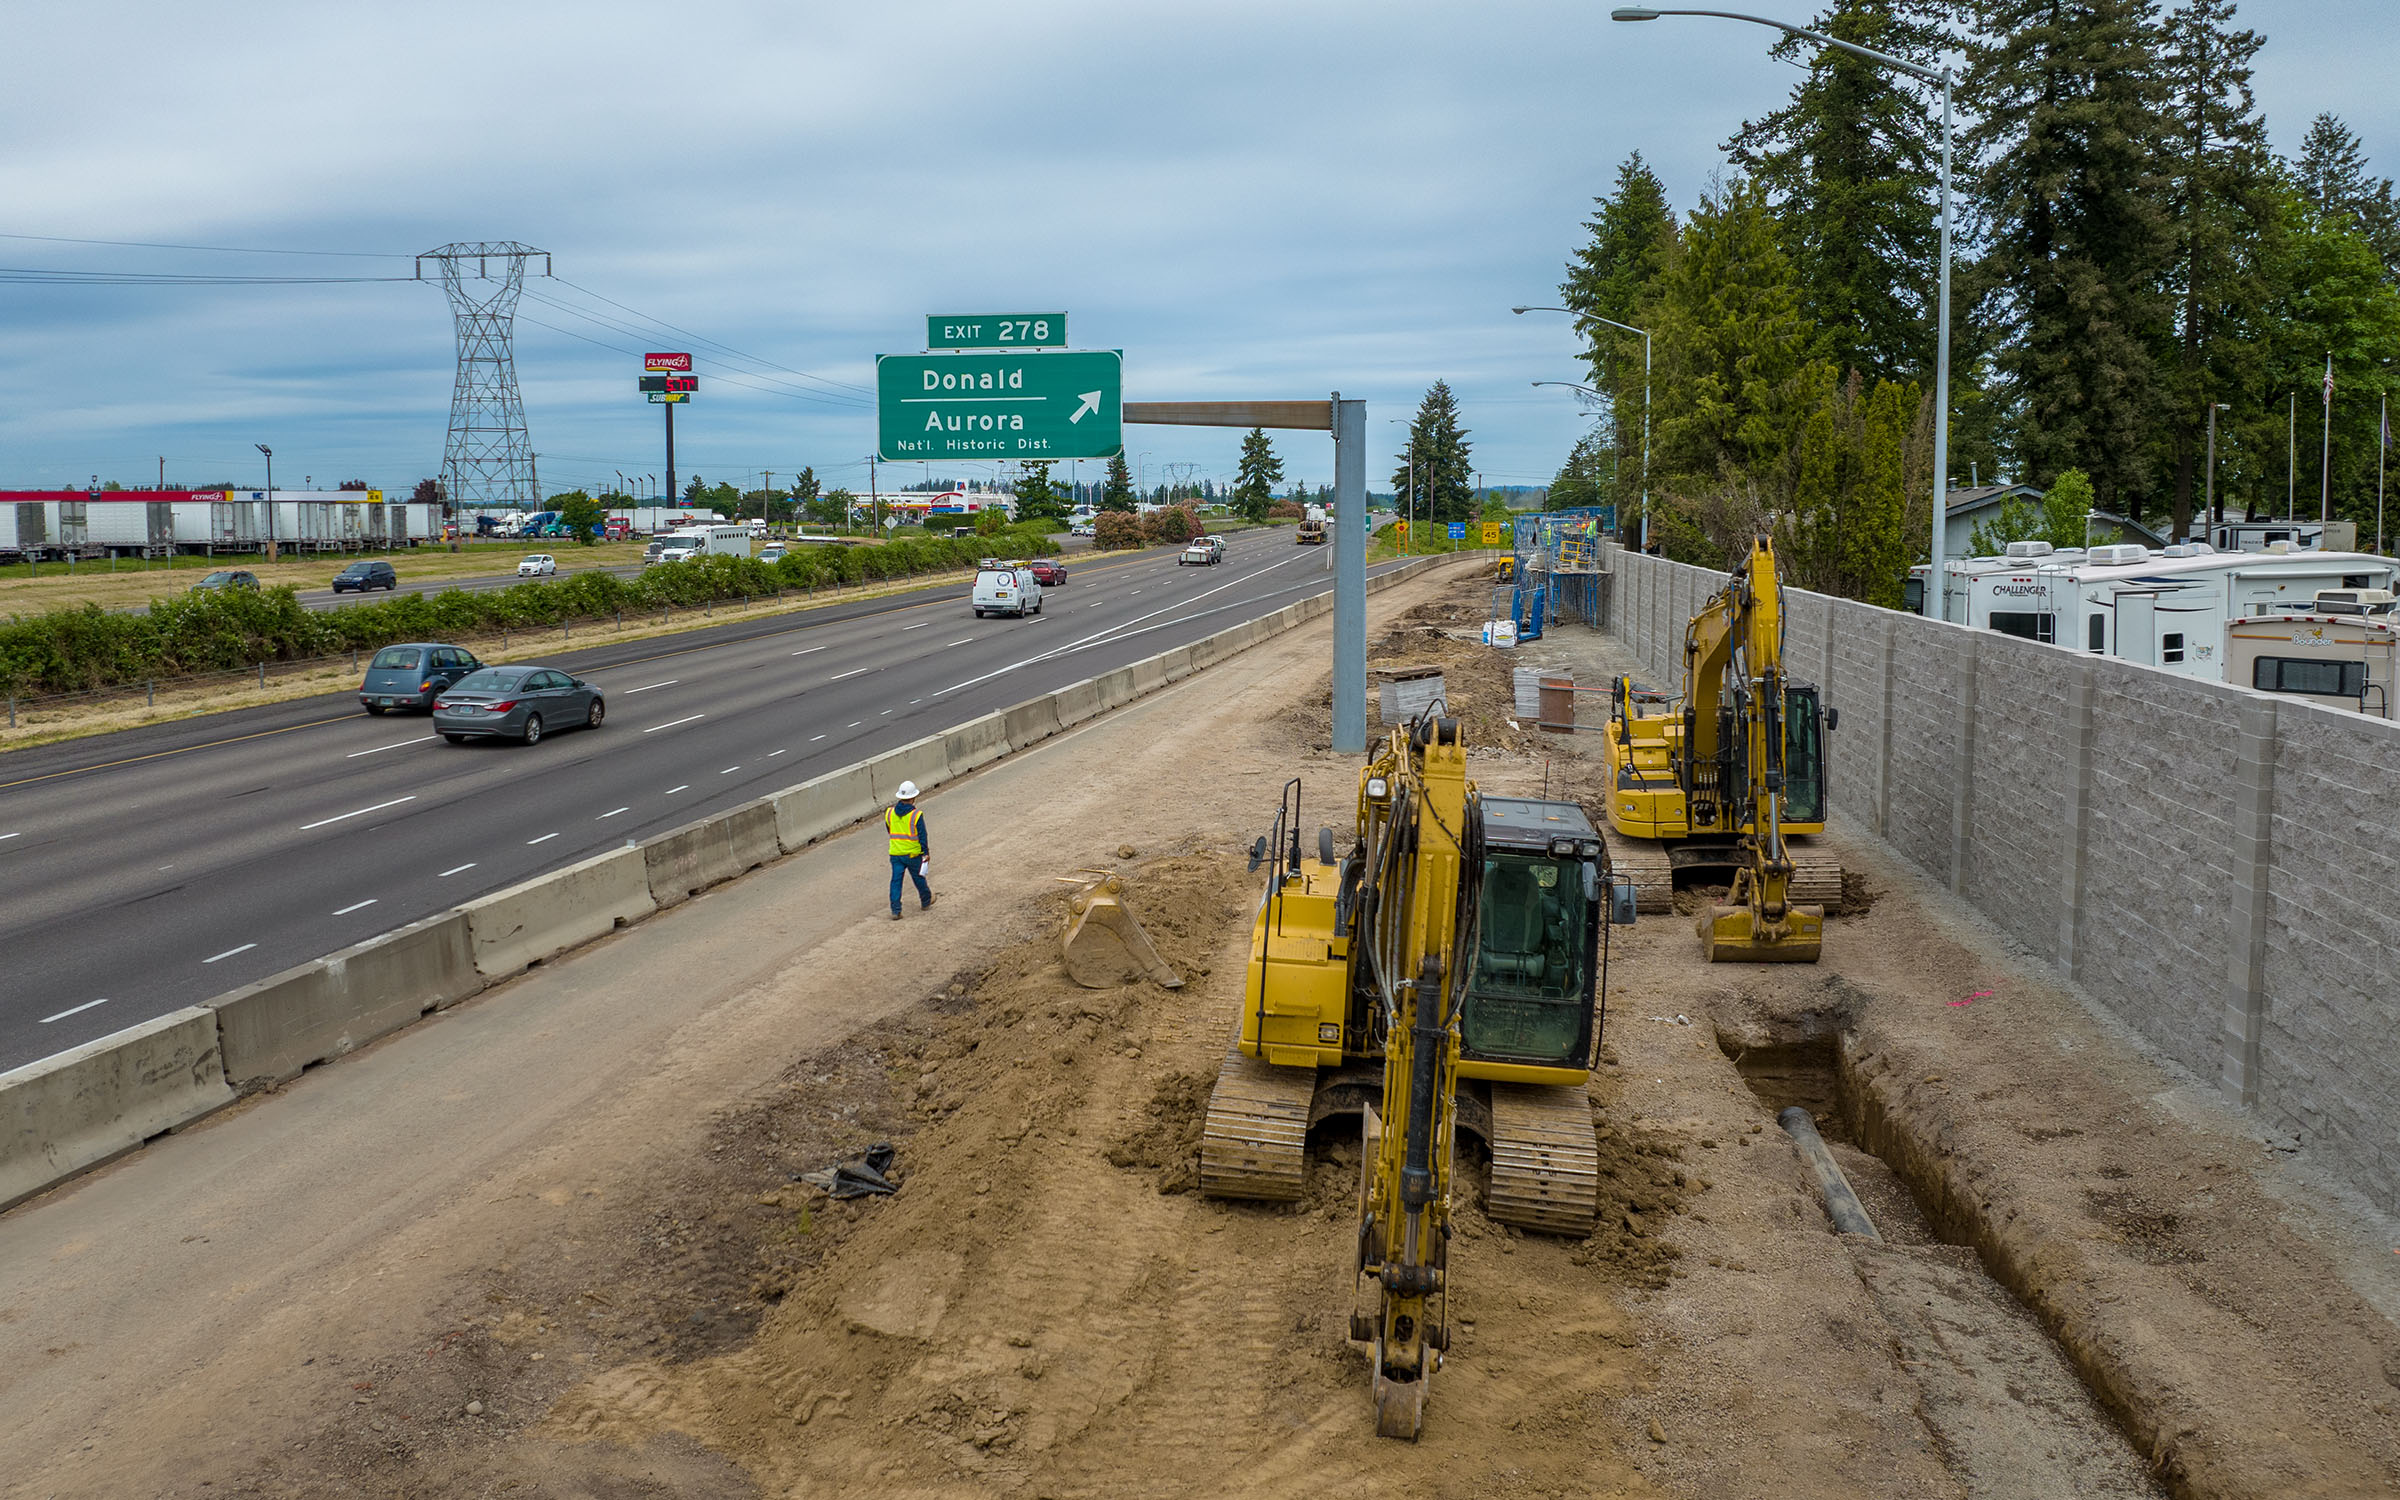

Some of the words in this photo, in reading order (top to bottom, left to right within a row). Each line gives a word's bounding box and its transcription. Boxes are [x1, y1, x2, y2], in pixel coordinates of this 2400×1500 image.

[944, 325, 982, 339] EXIT
[998, 320, 1049, 341] 278
[923, 368, 1023, 390] Donald
[650, 394, 684, 402] SUBWAY
[925, 411, 1024, 431] Aurora
[947, 439, 1005, 450] Historic
[1018, 438, 1051, 449] Dist.
[1992, 585, 2047, 597] CHALLENGER
[2293, 633, 2331, 646] Bounder
